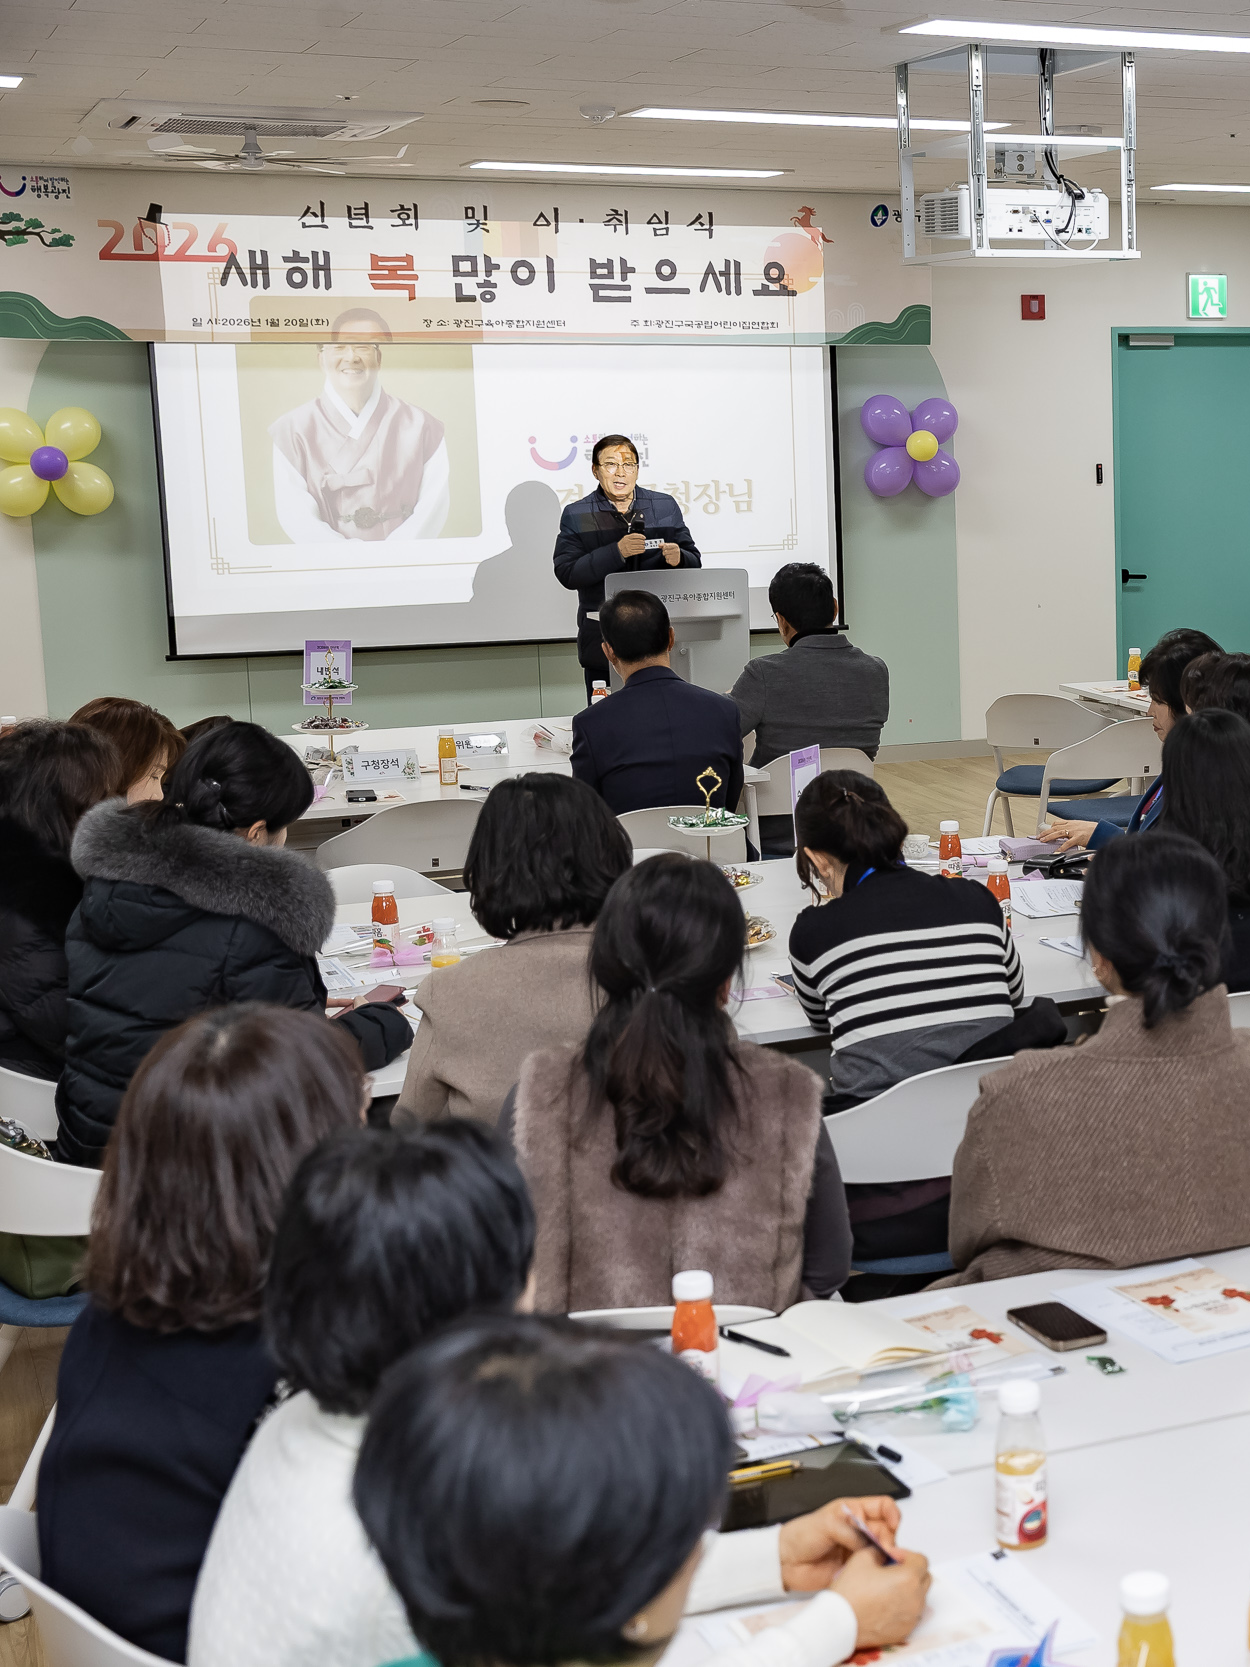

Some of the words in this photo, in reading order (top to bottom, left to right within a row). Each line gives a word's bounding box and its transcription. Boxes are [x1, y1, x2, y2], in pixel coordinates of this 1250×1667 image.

[30, 184, 71, 200] 행복광진
[298, 200, 419, 231] 신년회
[464, 205, 490, 234] 및
[97, 219, 238, 262] 2026
[220, 248, 333, 291] 새해
[367, 253, 419, 302] 복
[451, 254, 557, 304] 많이
[588, 256, 798, 304] 받으세요
[265, 317, 280, 328] 1월
[284, 317, 330, 328] 20일(화)
[453, 318, 566, 329] 광진구육아종합지원센터
[660, 591, 735, 603] 광진구육아종합지원센터
[361, 758, 400, 771] 구청장석
